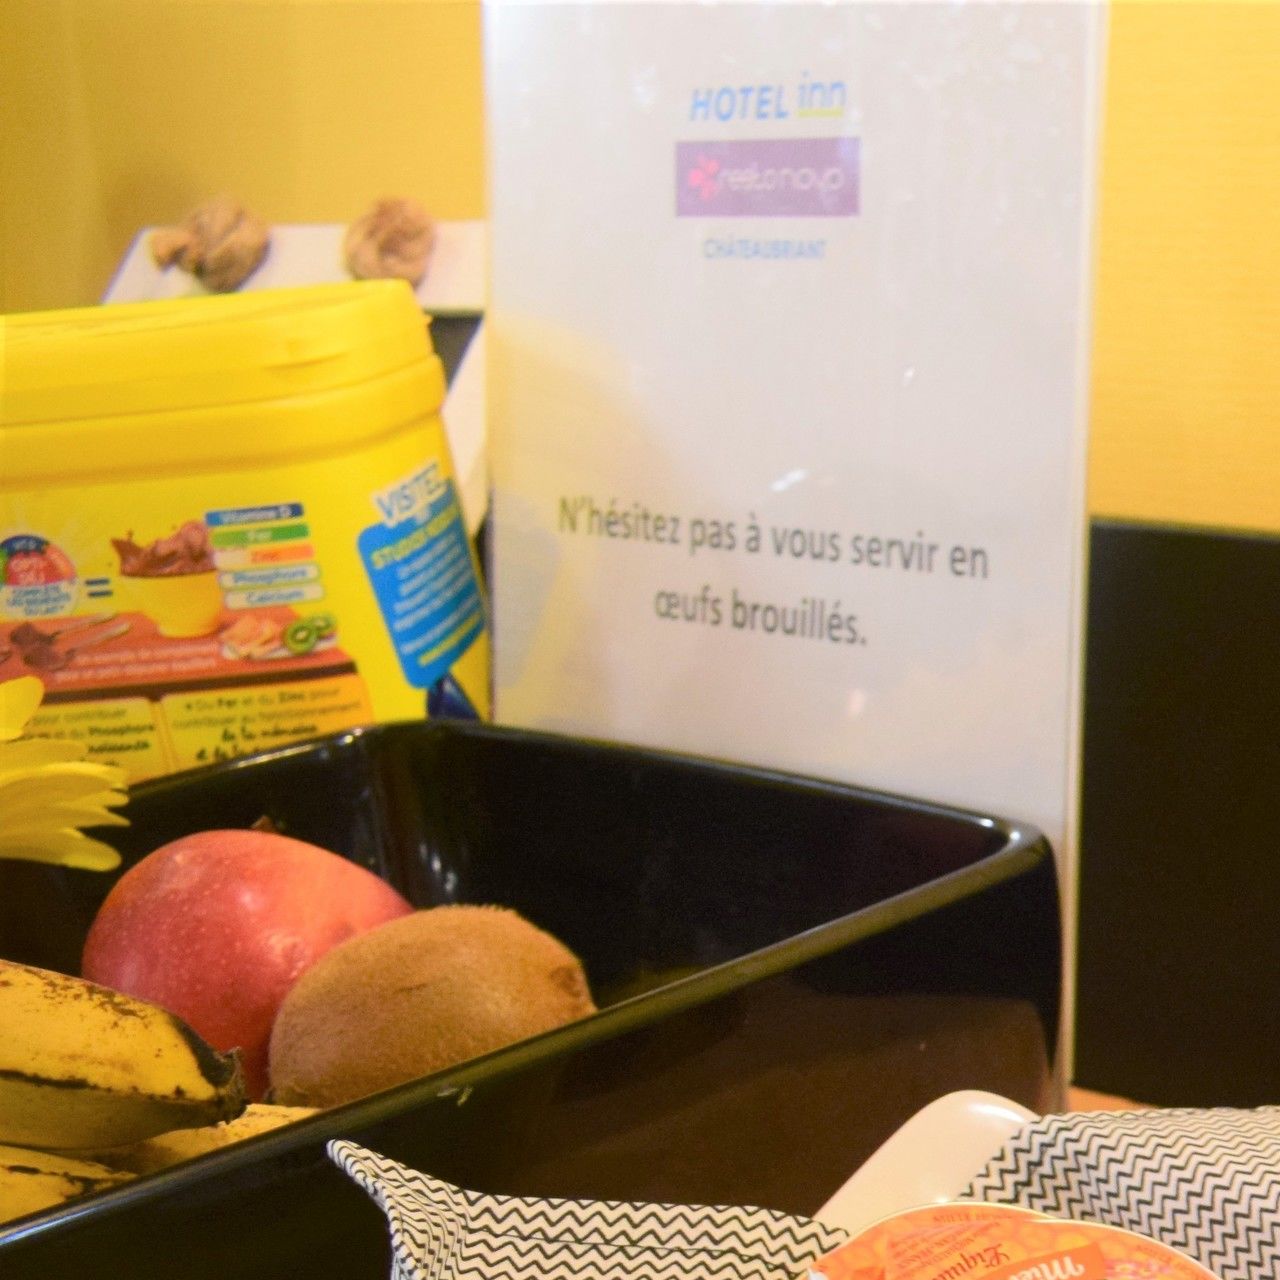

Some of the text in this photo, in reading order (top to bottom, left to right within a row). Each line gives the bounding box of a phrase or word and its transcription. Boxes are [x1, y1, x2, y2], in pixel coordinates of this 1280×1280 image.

[689, 69, 847, 122] HOTEL inn
[558, 496, 990, 580] N'hésitez pas à vous servir en
[654, 583, 868, 646] œufs brouillés.
